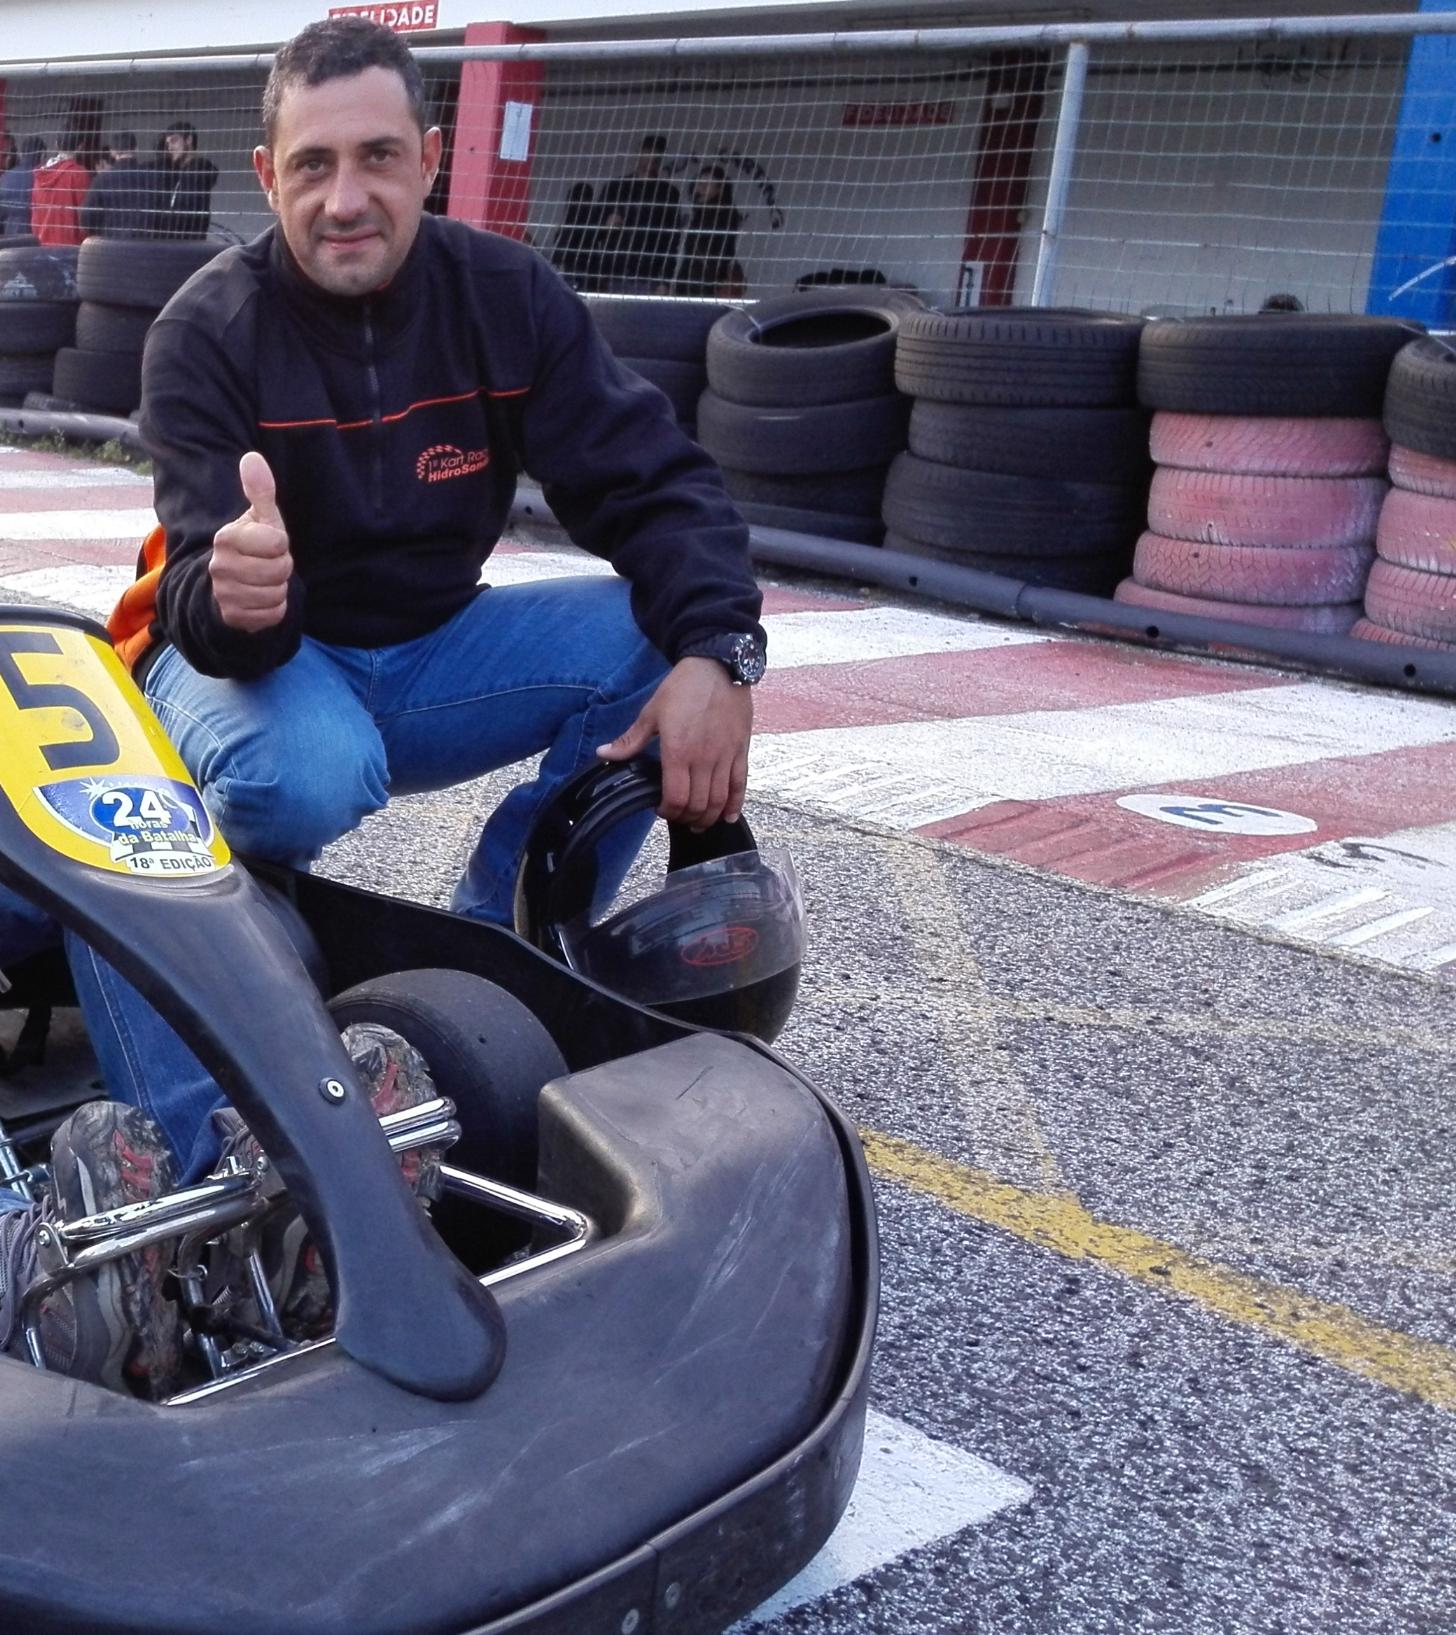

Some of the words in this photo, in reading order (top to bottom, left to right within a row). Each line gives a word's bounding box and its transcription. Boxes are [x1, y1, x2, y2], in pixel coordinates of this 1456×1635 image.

[332, 4, 435, 27] LIDADE
[440, 455, 464, 469] Kart
[102, 790, 172, 827] 24
[118, 832, 140, 846] da
[140, 830, 198, 844] Batalha
[159, 855, 212, 871] EDIÇÃO
